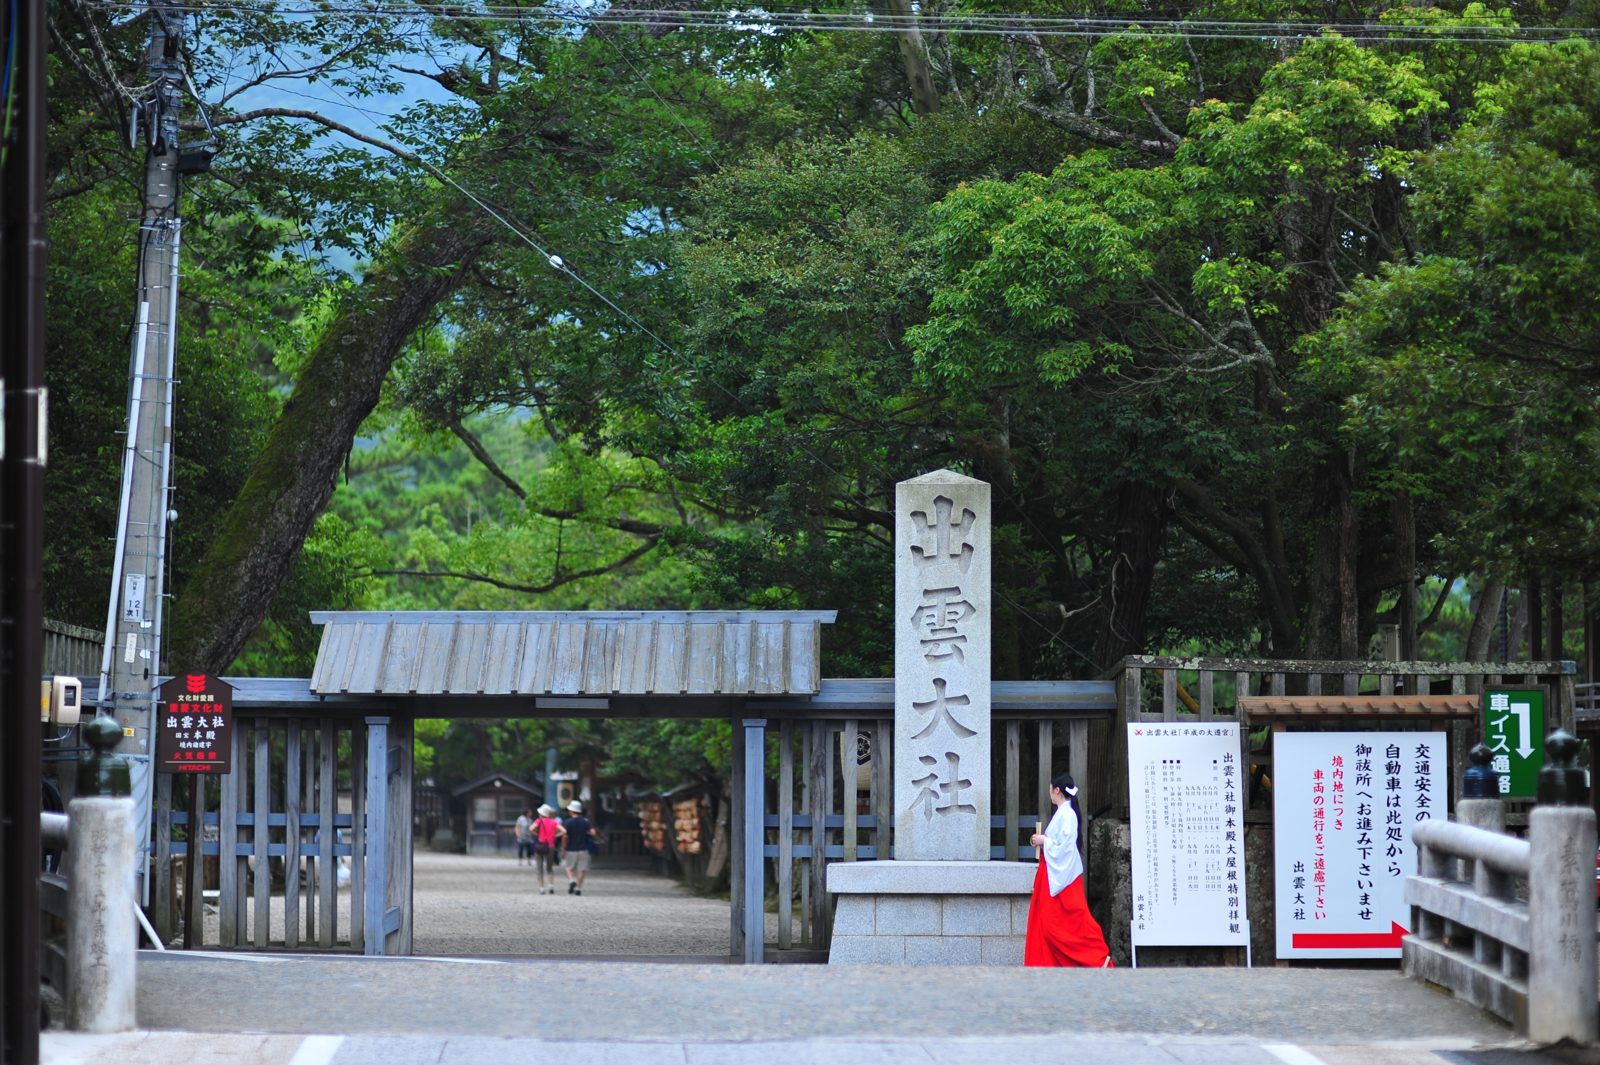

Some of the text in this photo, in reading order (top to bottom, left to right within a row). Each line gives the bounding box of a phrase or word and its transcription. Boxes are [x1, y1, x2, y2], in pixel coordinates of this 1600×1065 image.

[908, 494, 978, 822] 出雲大社
[166, 715, 225, 729] 出雲大社
[169, 703, 224, 713] 重要文化財
[177, 694, 214, 702] 文化財愛護
[1331, 755, 1345, 831] 境内地につき
[1385, 744, 1403, 877] 自動車は此処から
[1414, 743, 1432, 822] 交通安全の
[1223, 752, 1240, 934] 出雲大社御本殿大屋根特別拝観
[1312, 769, 1326, 920] 車両の通行をご遠慮下さい
[1355, 744, 1373, 921] 御祓所へお進み下さいませ
[1137, 894, 1146, 931] 出雲大社
[1293, 861, 1306, 921] 出雲大社
